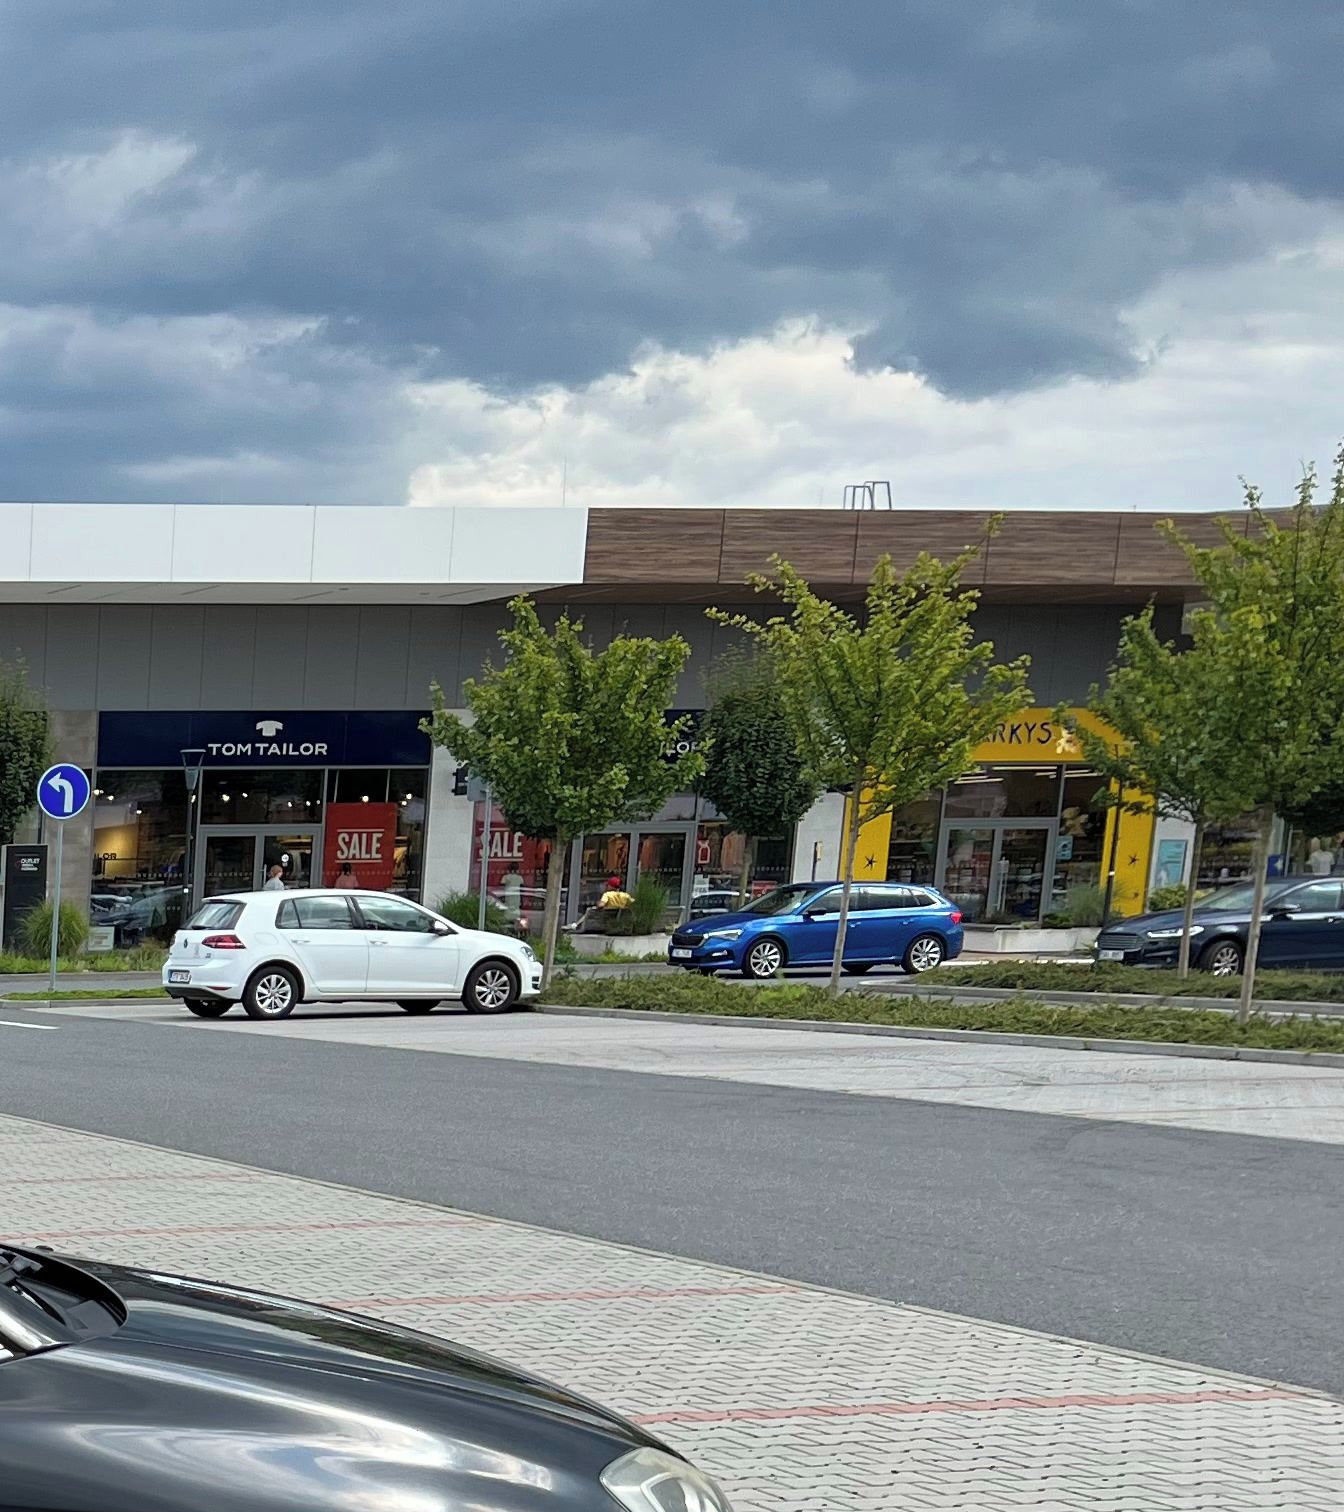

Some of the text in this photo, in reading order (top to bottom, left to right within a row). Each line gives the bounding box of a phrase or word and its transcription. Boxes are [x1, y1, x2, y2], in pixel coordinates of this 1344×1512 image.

[207, 743, 328, 756] TOM TAILOR
[337, 833, 383, 859] SALE
